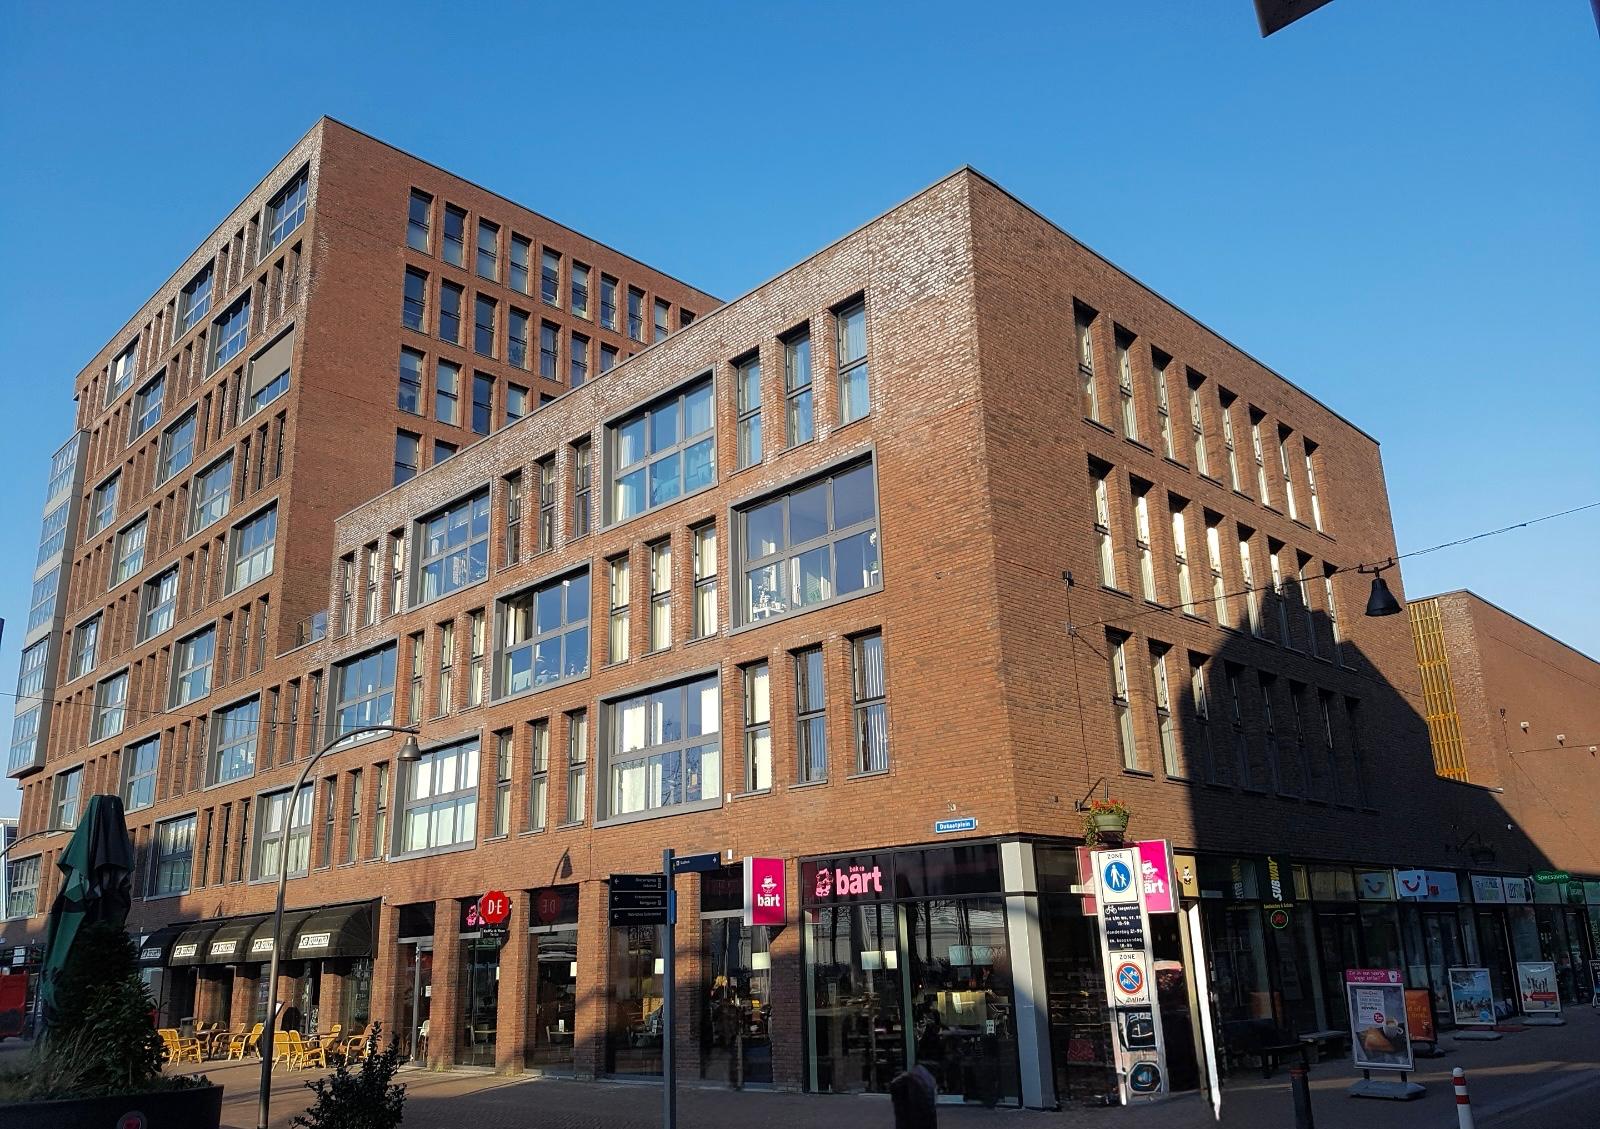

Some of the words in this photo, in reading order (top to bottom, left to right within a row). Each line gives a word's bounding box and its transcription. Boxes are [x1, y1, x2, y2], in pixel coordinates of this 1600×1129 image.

[835, 866, 883, 896] bart
[1267, 855, 1283, 902] SUBWAY
[1537, 873, 1569, 881] Specsavers
[1143, 879, 1165, 894] art
[757, 893, 780, 907] bart
